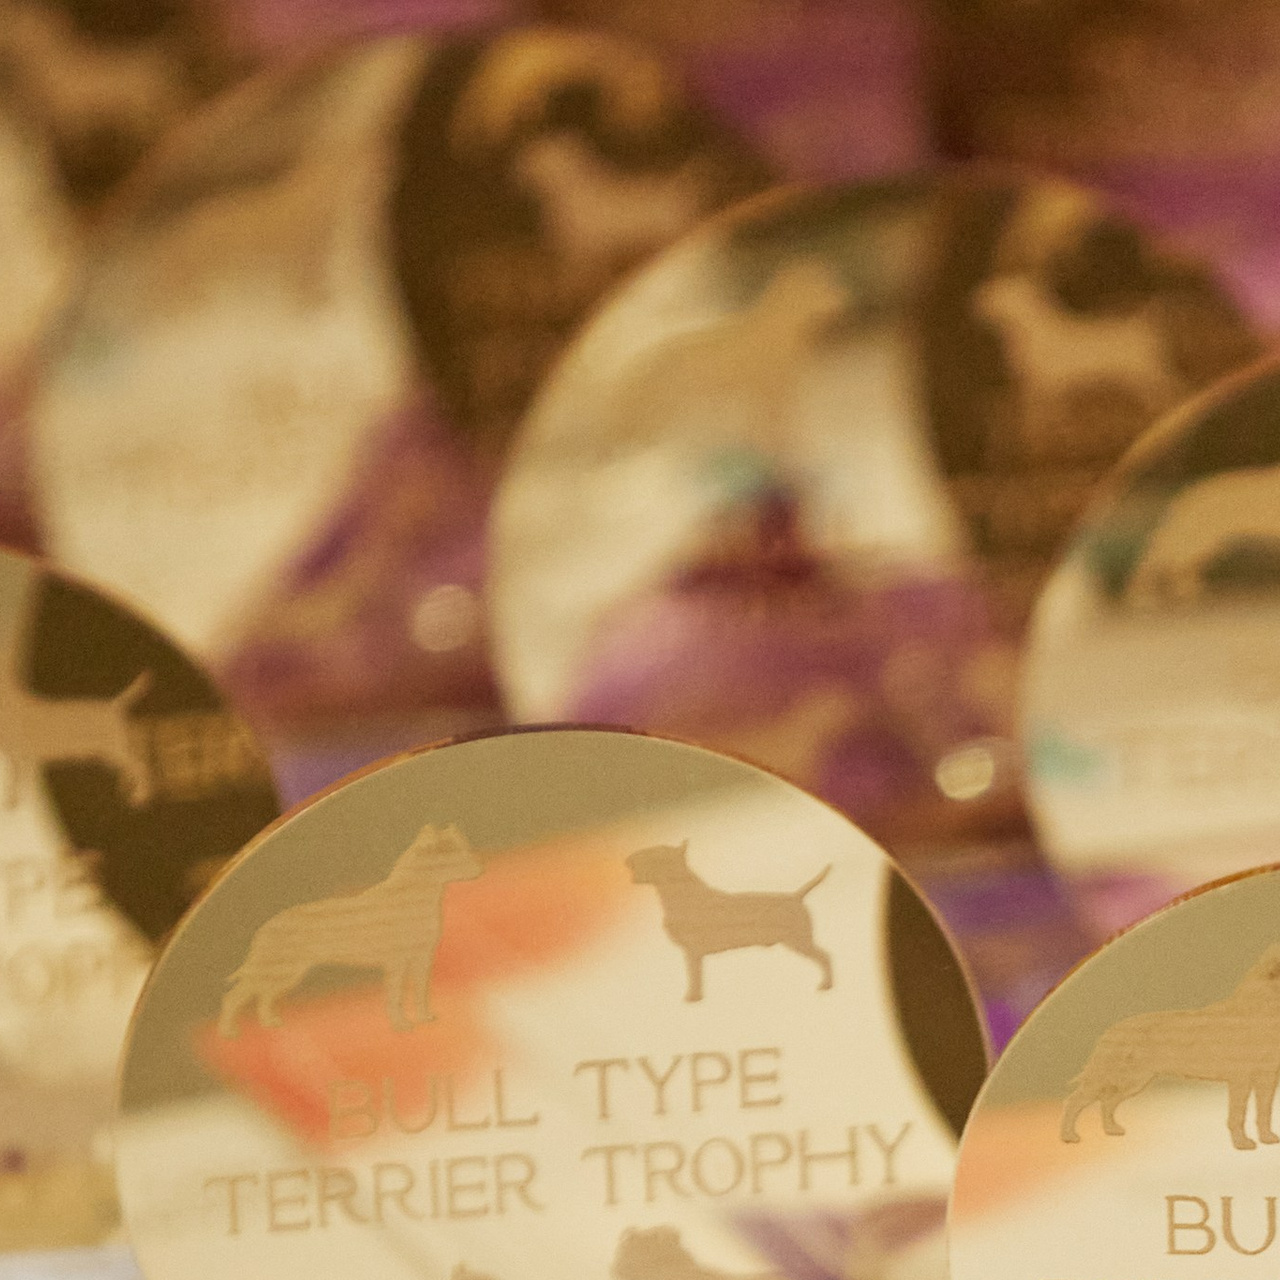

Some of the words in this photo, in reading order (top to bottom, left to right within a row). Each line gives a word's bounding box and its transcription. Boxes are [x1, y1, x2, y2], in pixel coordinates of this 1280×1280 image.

[328, 1068, 540, 1140] BULL
[572, 1047, 783, 1121] TYPE
[202, 1152, 547, 1236] TERRIER
[580, 1120, 913, 1206] TROPHY
